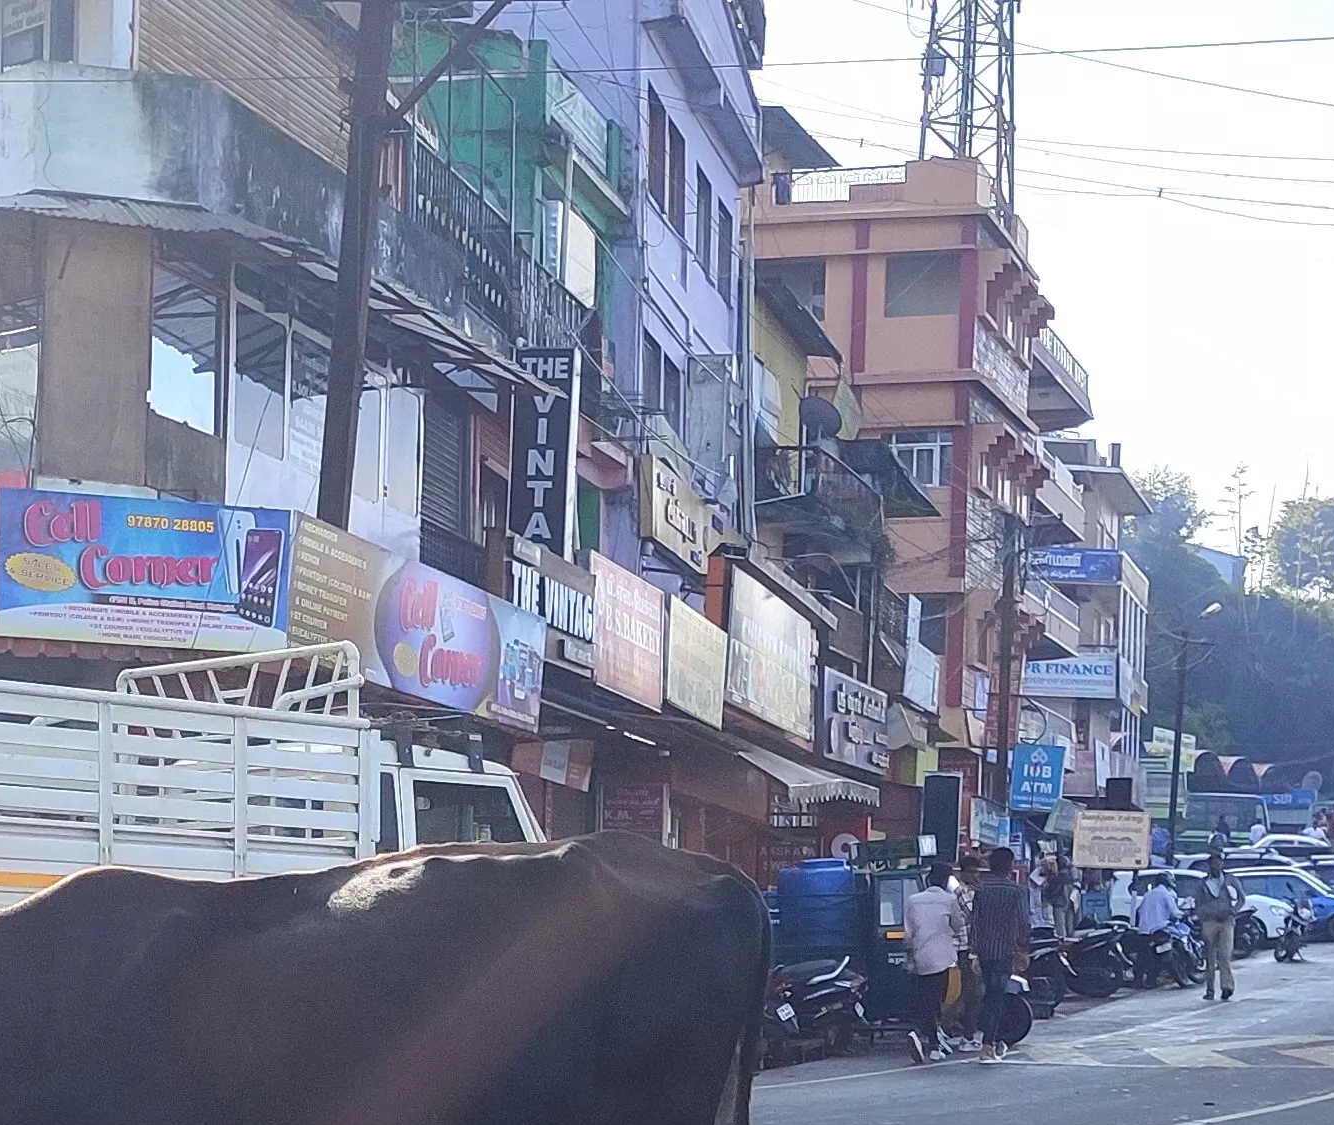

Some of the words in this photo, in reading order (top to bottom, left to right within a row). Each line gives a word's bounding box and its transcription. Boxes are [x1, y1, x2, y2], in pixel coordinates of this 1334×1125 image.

[521, 357, 569, 379] THE
[23, 500, 102, 547] Cell
[127, 515, 169, 530] 97870
[23, 557, 61, 572] SALES
[79, 545, 217, 590] Corner
[20, 569, 69, 586] SERVICE
[512, 561, 540, 615] THE
[1045, 663, 1113, 676] FINANCE
[1023, 763, 1052, 779] IOB
[1020, 780, 1053, 794] ATM
